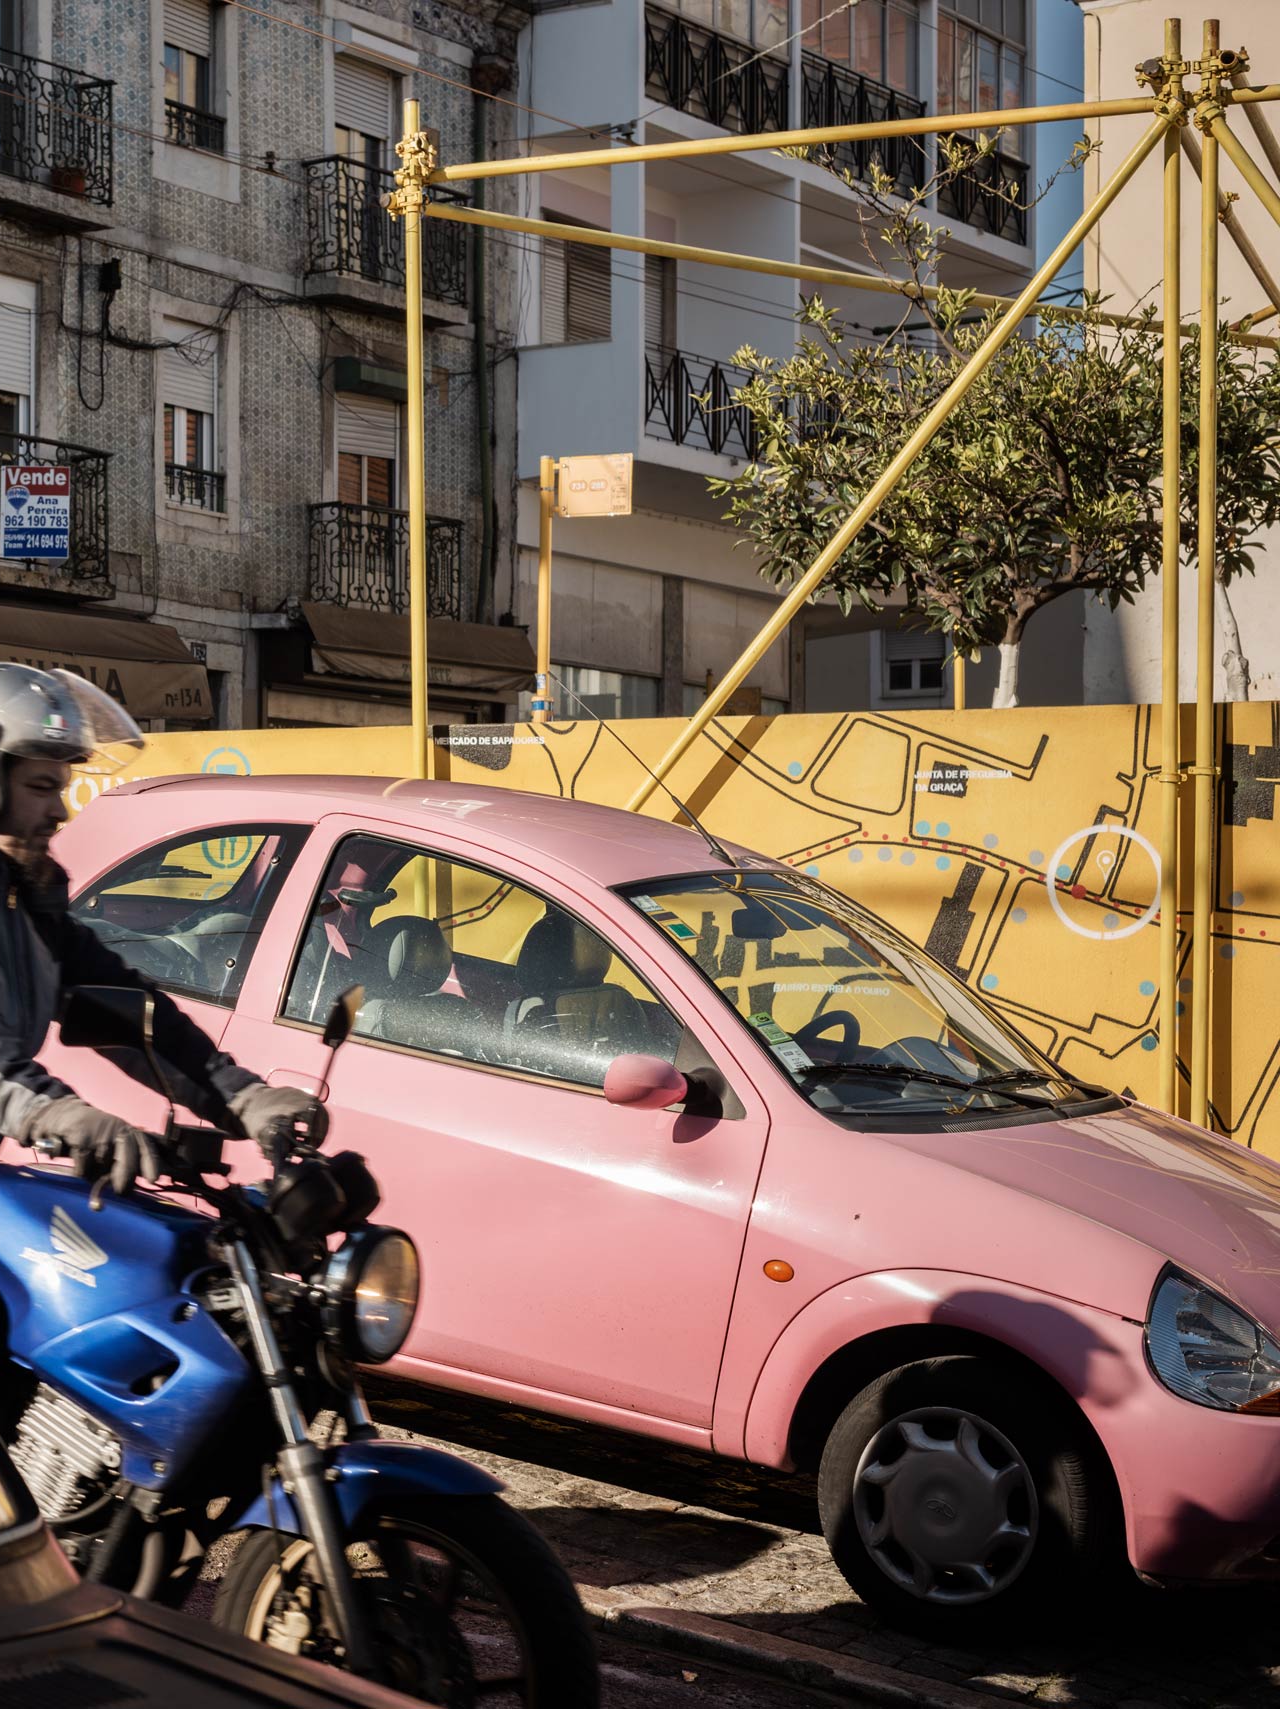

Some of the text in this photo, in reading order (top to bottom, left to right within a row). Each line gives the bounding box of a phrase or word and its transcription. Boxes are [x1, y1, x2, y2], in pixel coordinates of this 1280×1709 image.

[7, 467, 67, 486] Vende
[37, 496, 58, 505] Ana
[27, 505, 68, 515] Pereira
[5, 515, 69, 527] 962 190 783
[5, 541, 24, 549] Team
[26, 534, 39, 548] 214
[55, 534, 68, 549] 975
[434, 736, 545, 745] MERCADO DE SAPADORES
[914, 769, 1013, 779] JUNTA DE FREGUESIA
[914, 782, 964, 793] DA GRAÇA
